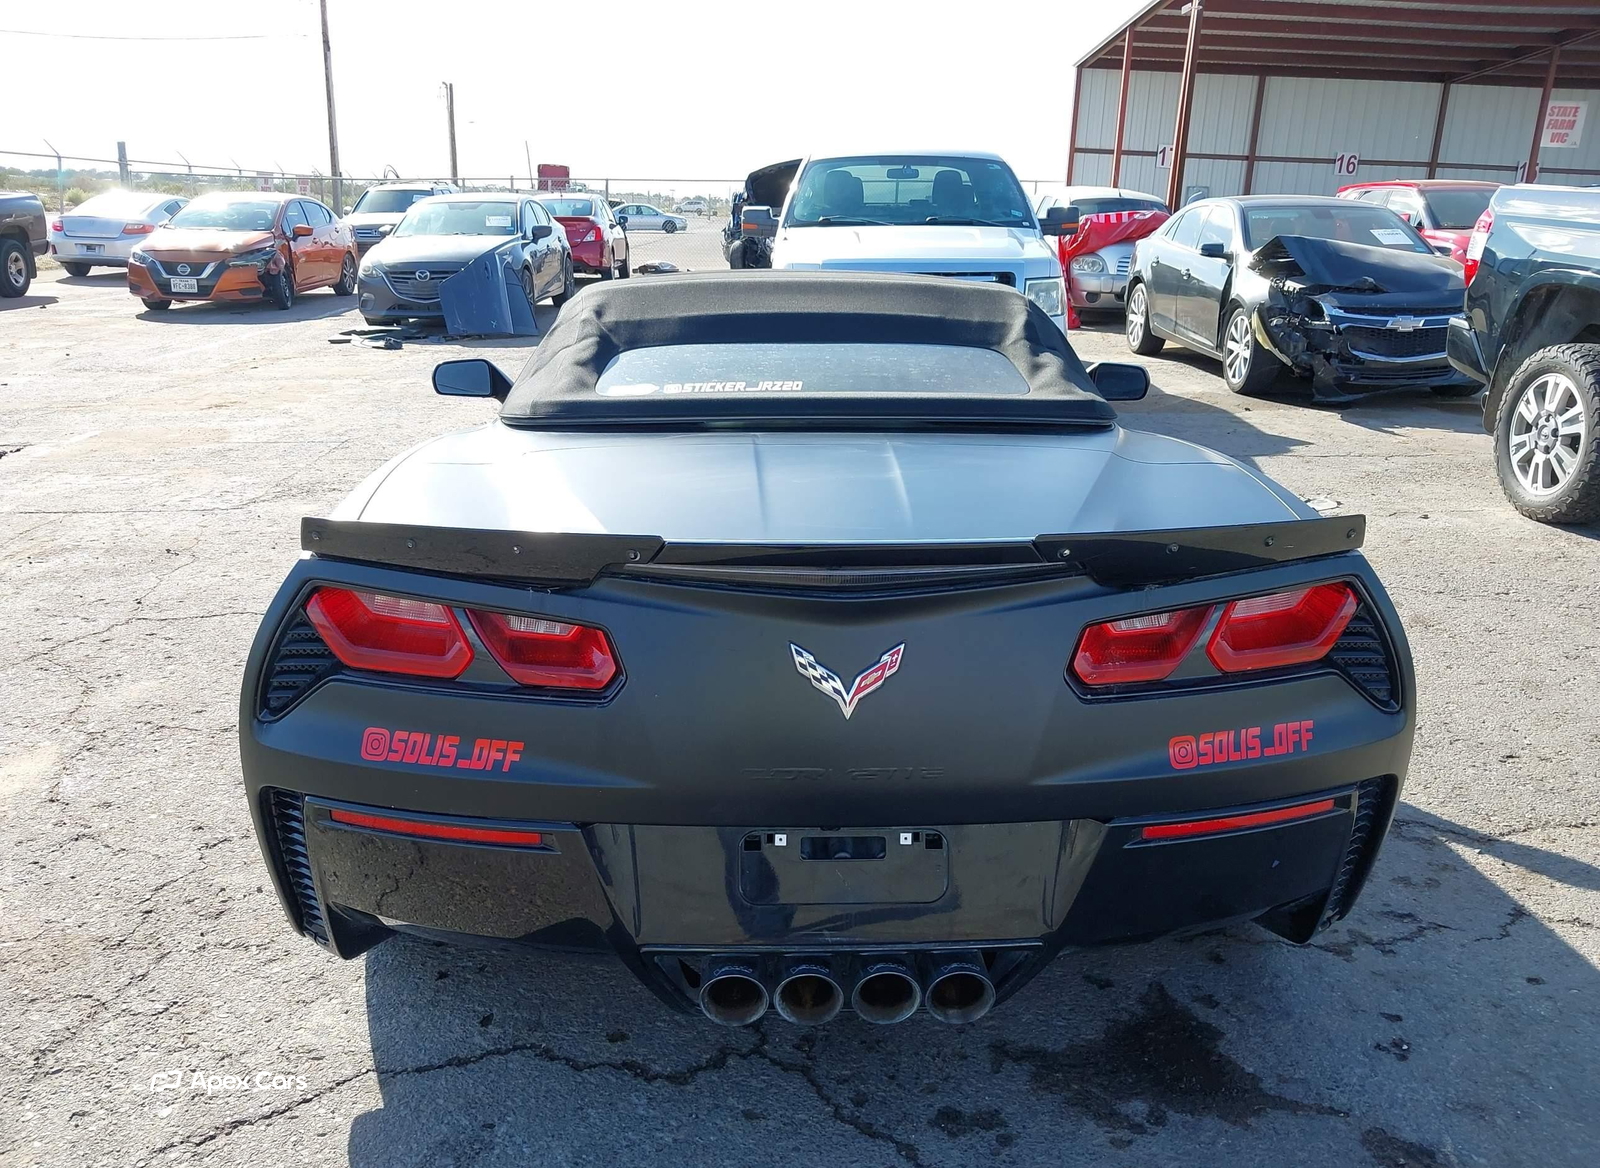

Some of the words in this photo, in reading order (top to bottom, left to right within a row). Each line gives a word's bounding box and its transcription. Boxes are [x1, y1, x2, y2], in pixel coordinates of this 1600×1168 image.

[1548, 105, 1580, 118] STATE
[1546, 119, 1577, 130] FARM
[1550, 132, 1569, 144] VIC
[1336, 154, 1357, 174] 16
